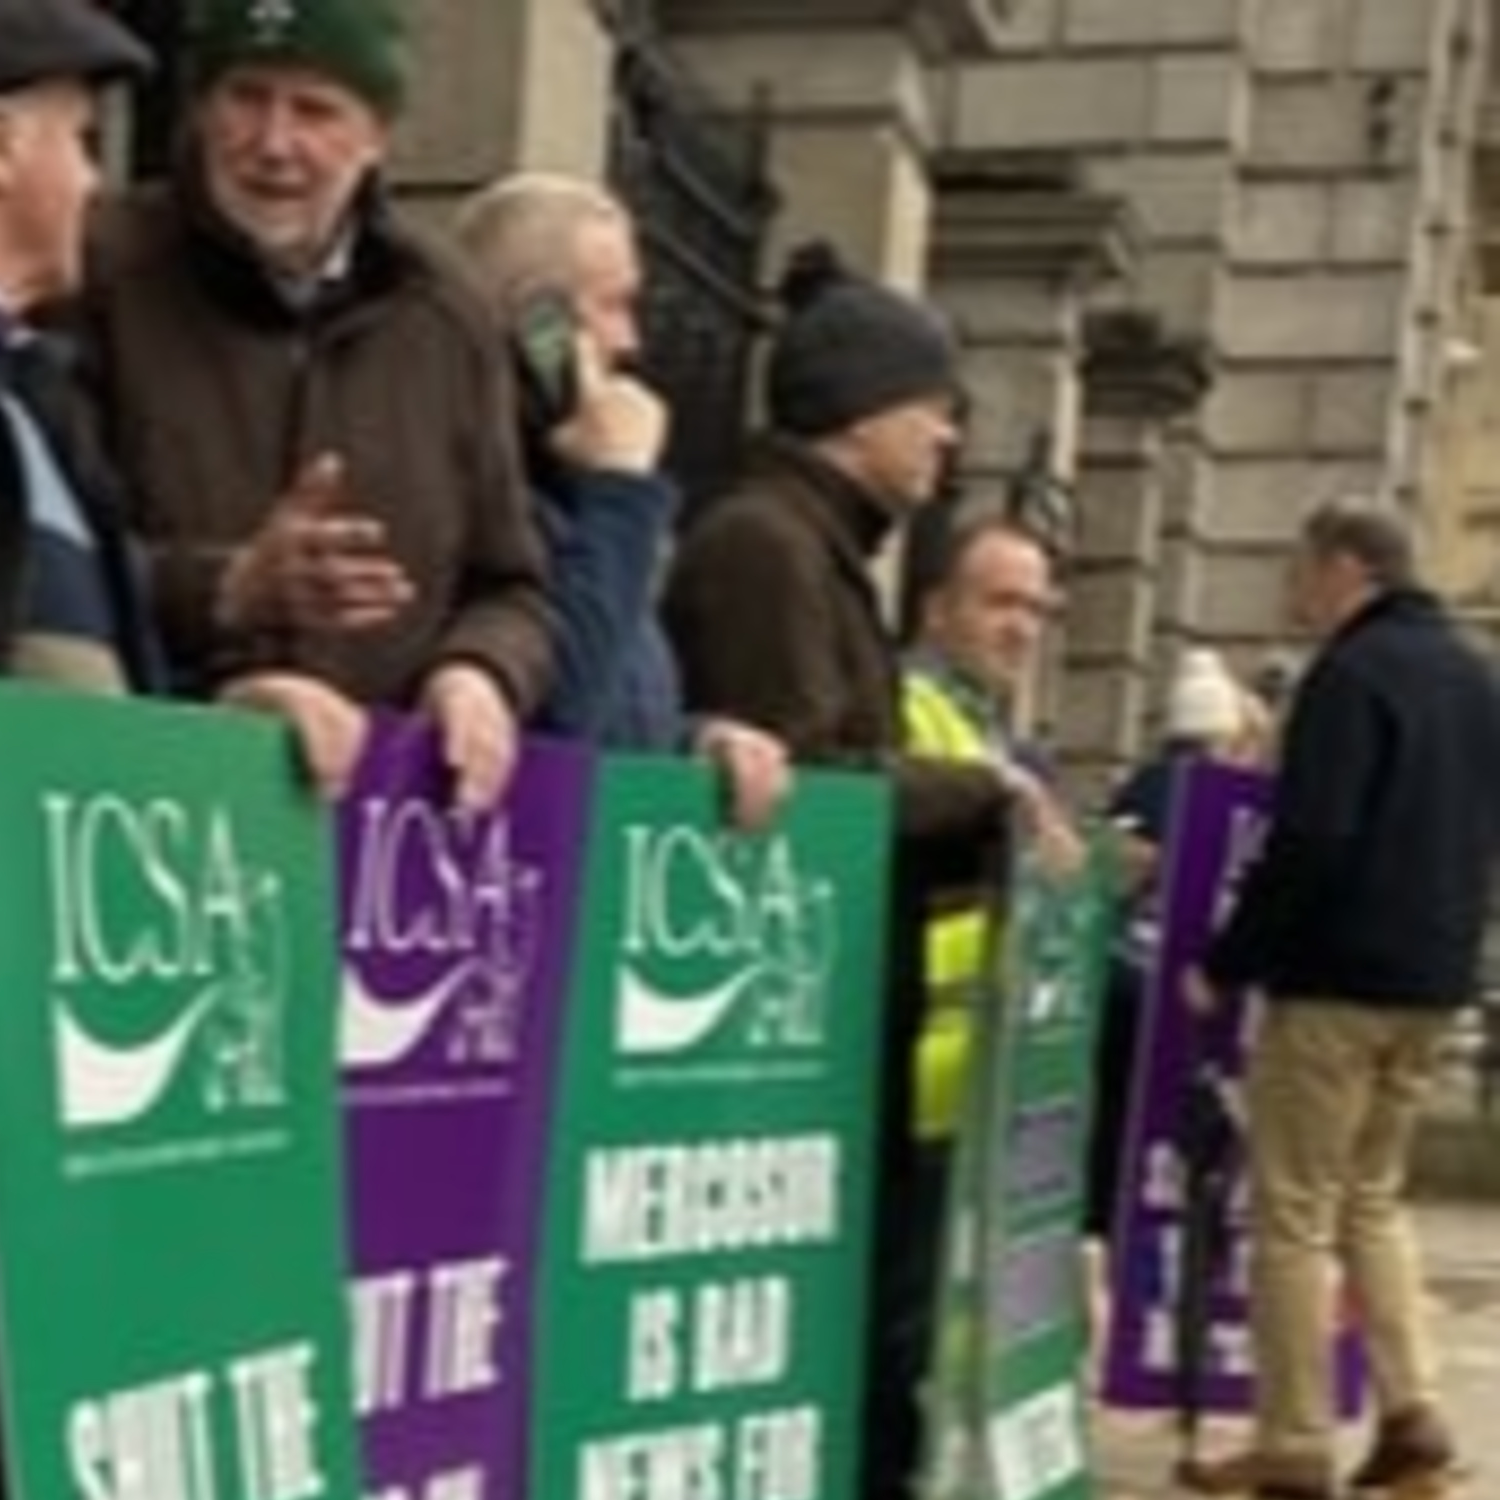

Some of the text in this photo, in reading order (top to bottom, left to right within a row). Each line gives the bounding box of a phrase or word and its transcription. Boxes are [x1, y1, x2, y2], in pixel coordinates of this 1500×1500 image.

[43, 793, 254, 984] ICSA
[622, 824, 802, 957] ICSA
[579, 1131, 839, 1265] MERCOSUR
[422, 1255, 510, 1402] THE
[627, 1275, 791, 1401] IS BAD
